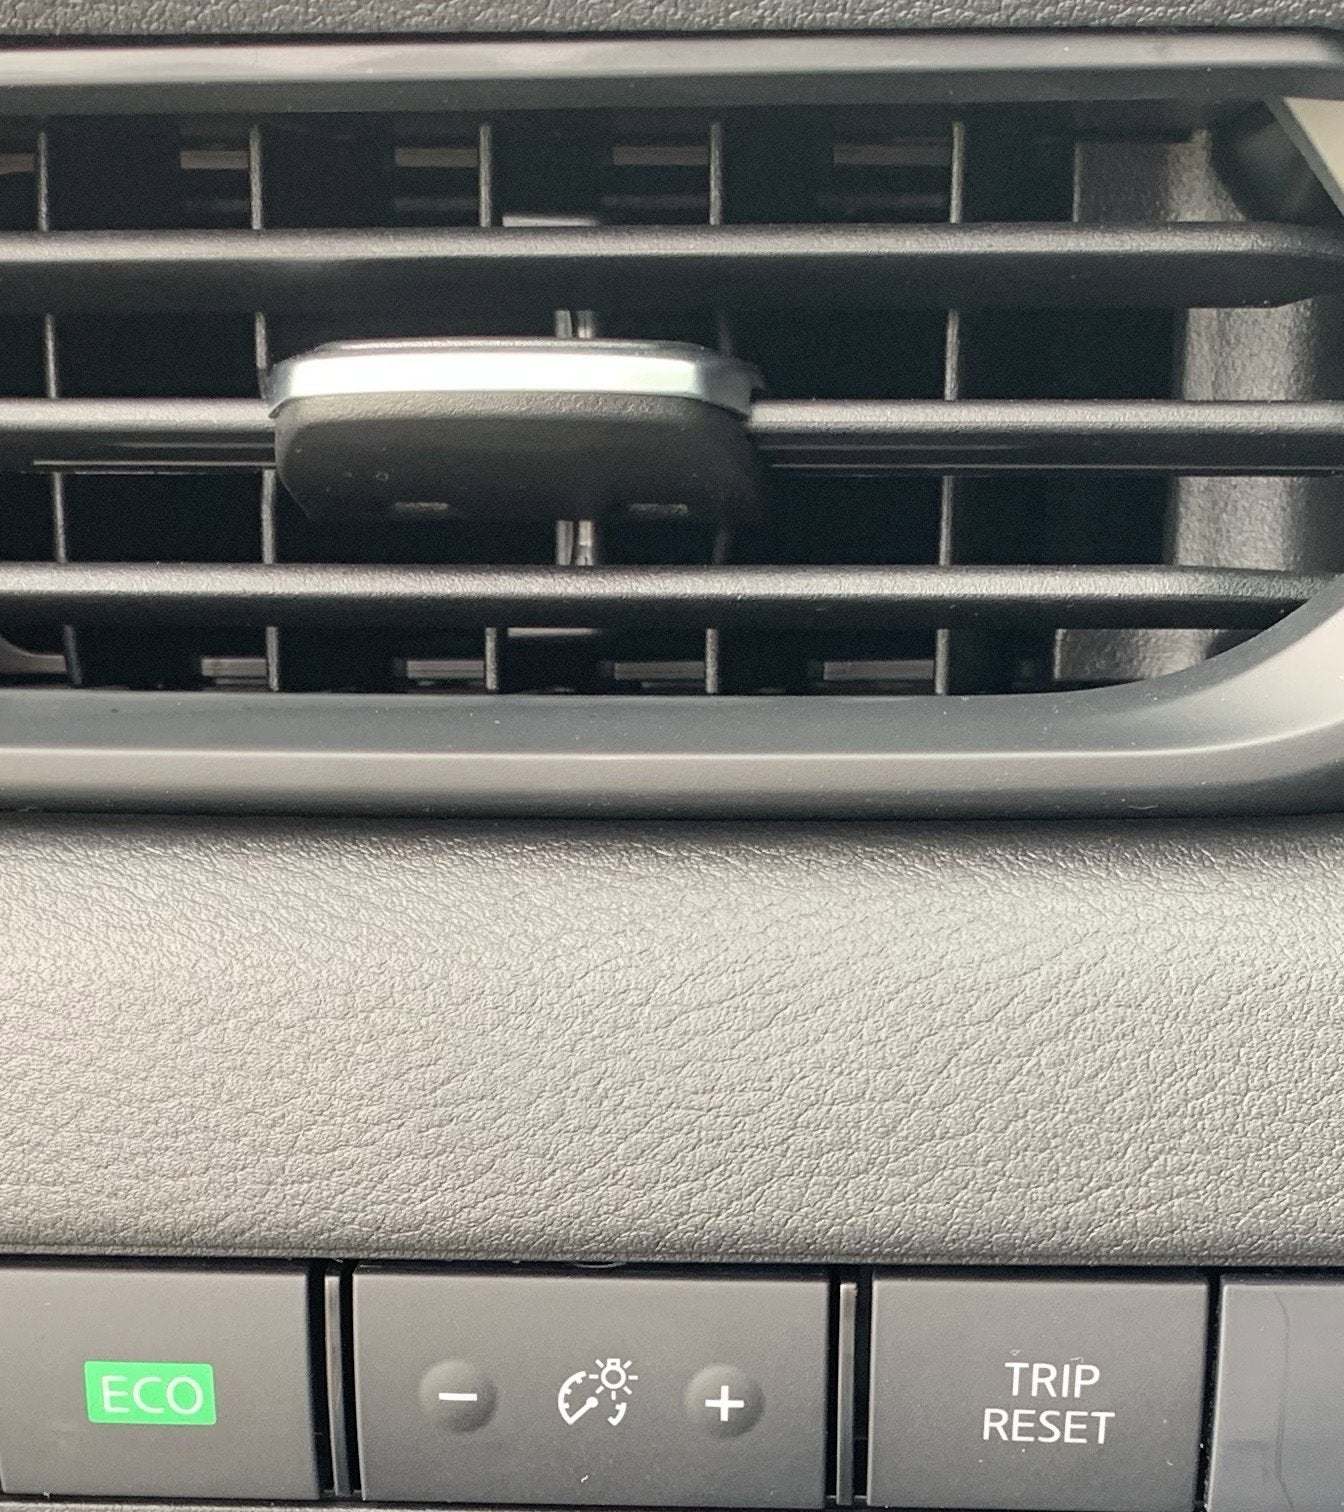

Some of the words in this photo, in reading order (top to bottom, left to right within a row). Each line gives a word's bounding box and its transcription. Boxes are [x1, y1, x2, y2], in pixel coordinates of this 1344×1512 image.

[101, 1374, 204, 1415] ECO
[1004, 1362, 1101, 1399] TRIP
[982, 1408, 1116, 1445] RESET
